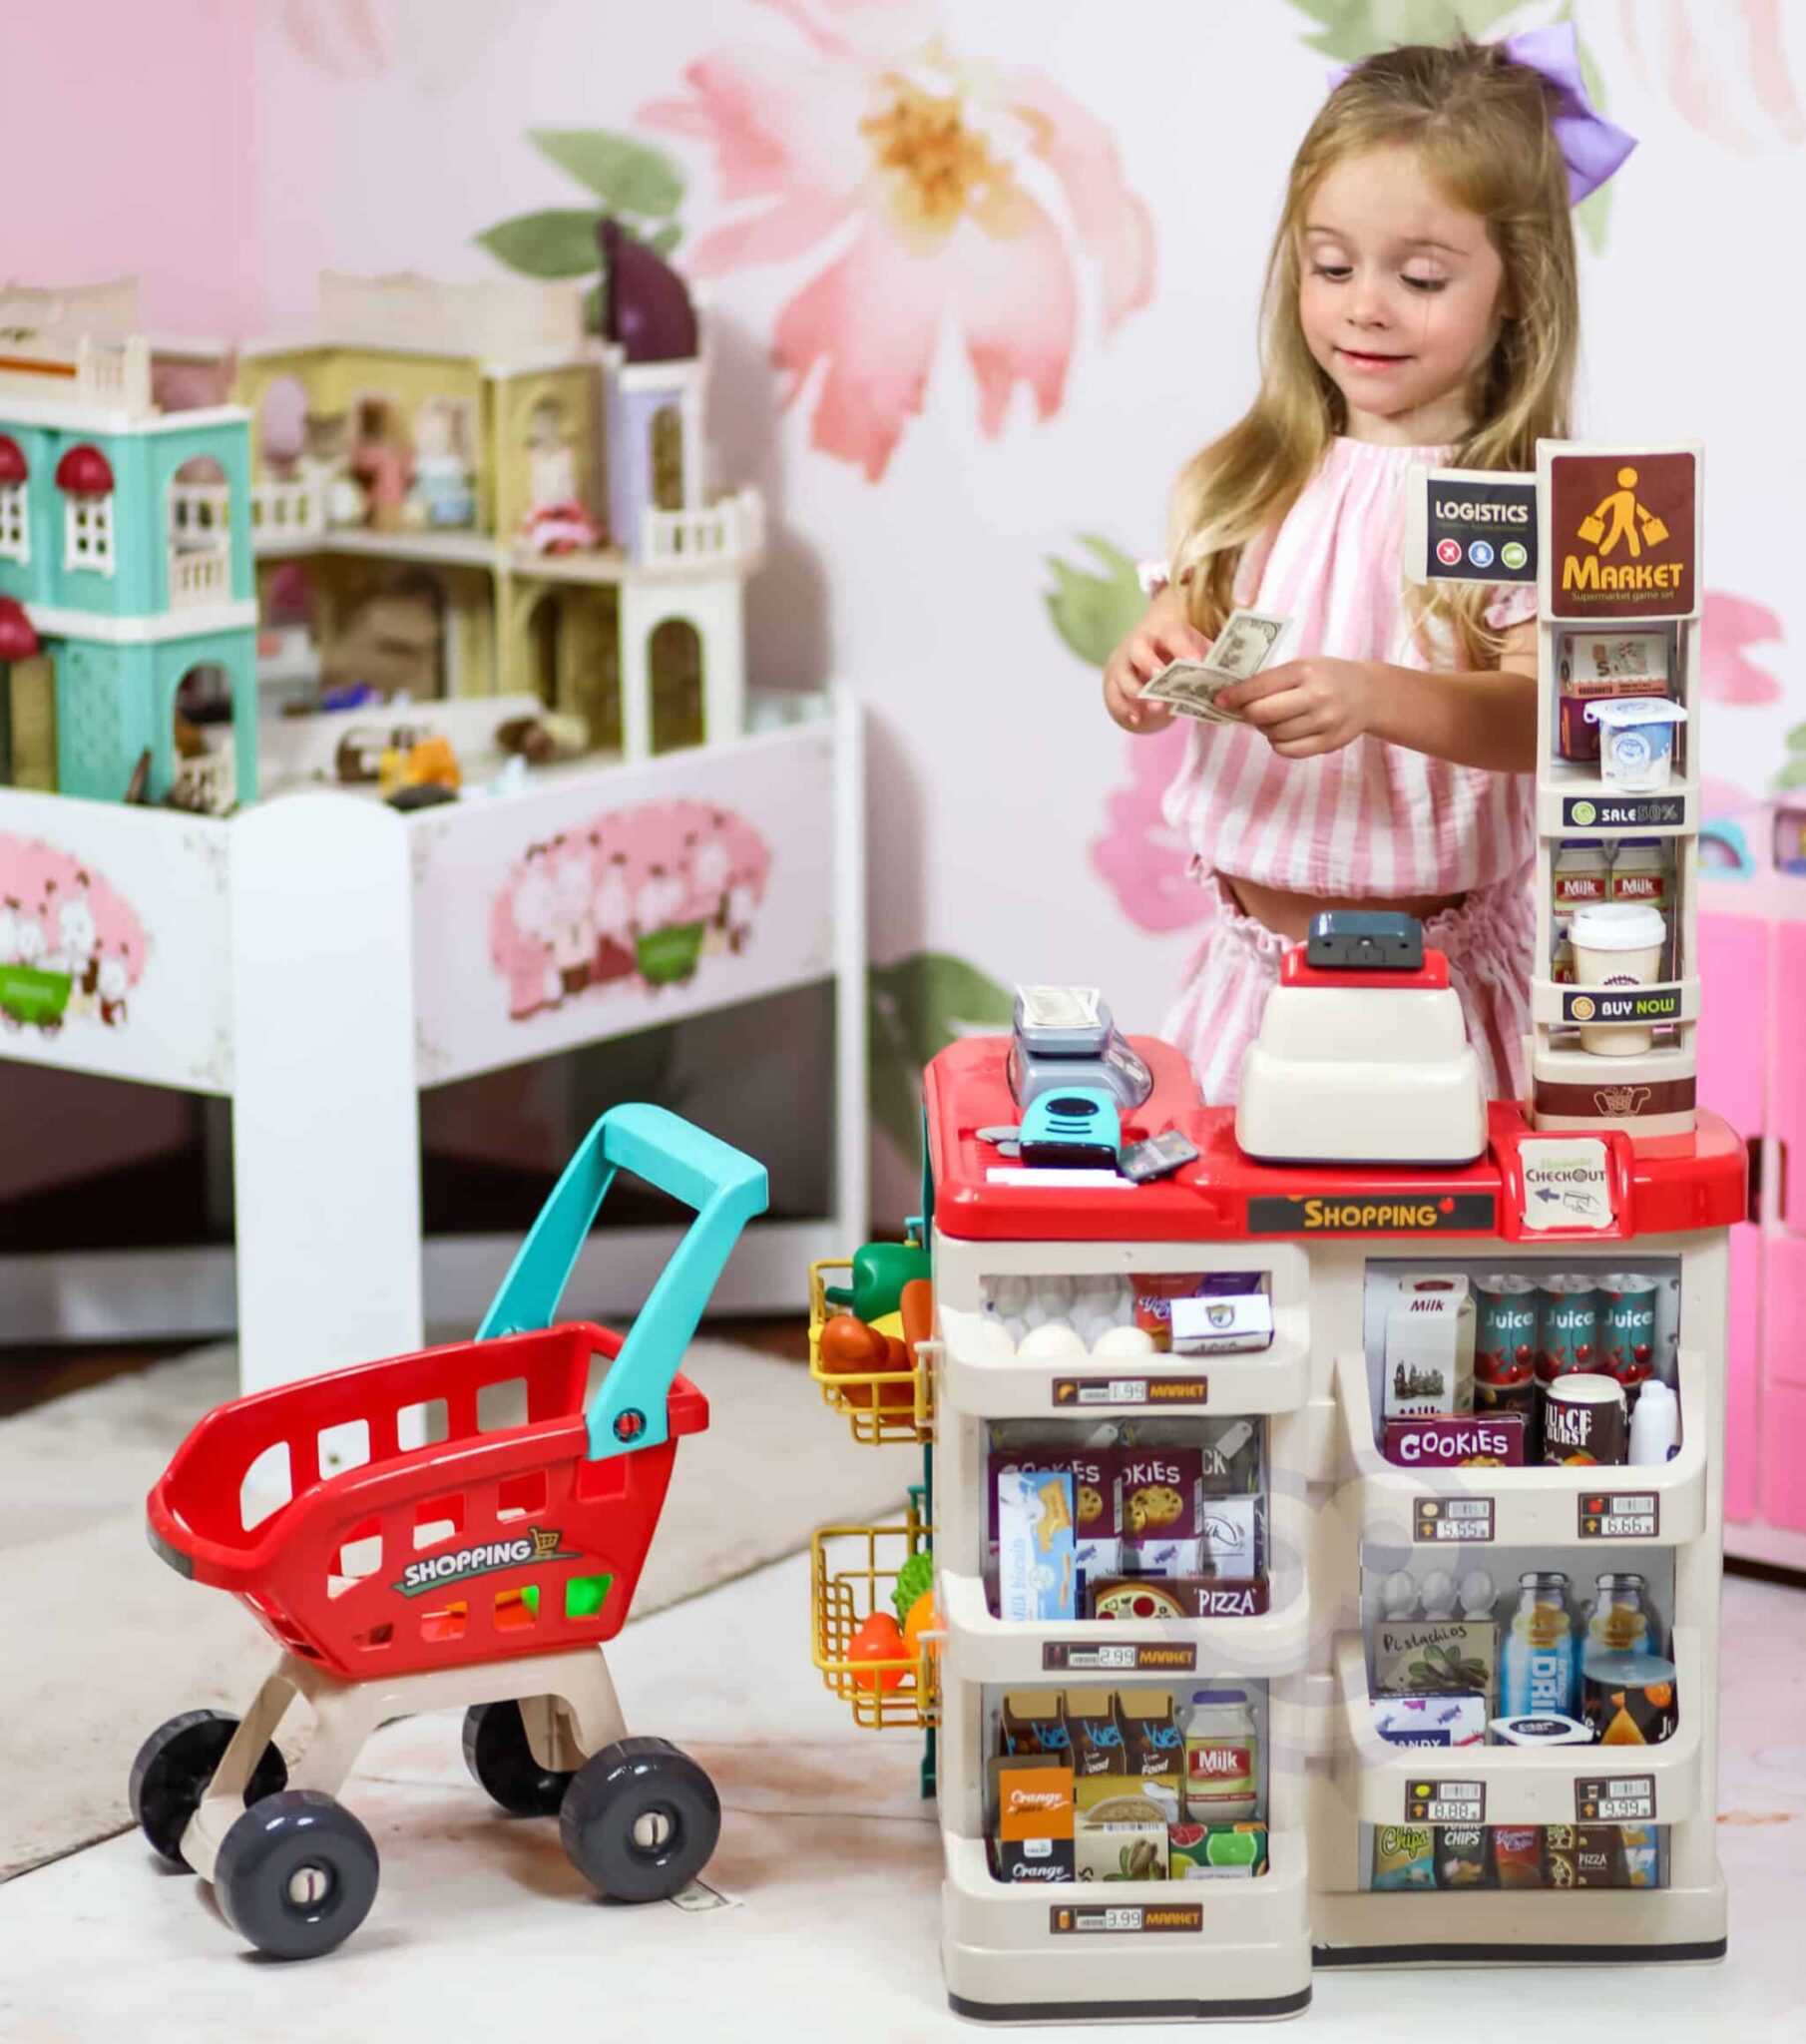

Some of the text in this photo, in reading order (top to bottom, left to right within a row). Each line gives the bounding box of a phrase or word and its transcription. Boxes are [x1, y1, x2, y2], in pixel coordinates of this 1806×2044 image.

[1436, 500, 1529, 523] LOGISTICS
[1563, 554, 1684, 590] MARKET
[1572, 590, 1674, 603] Supermarket game set
[1601, 803, 1677, 822] SALE 50%
[1564, 880, 1596, 895] Milk
[1621, 878, 1654, 894] Milk
[1601, 998, 1675, 1016] BUY NOW
[1304, 1199, 1438, 1228] SHOPPING
[1411, 1299, 1445, 1312] Milk
[1486, 1309, 1534, 1329] Juice
[1548, 1309, 1595, 1329] Juice
[1605, 1308, 1653, 1328] Juice
[1400, 1429, 1509, 1460] COOKIES
[404, 1540, 532, 1587] SHOPPING
[1199, 1590, 1255, 1616] PIZZA
[1100, 1649, 1134, 1664] 2.99
[1199, 1750, 1237, 1773] Milk
[1010, 1789, 1064, 1809] Orange
[1381, 1824, 1429, 1859] Chips
[1444, 1830, 1481, 1846] CHIPS
[1579, 1853, 1608, 1865] PIZZA
[1013, 1862, 1066, 1881] Orange
[1107, 1910, 1140, 1927] 3.99
